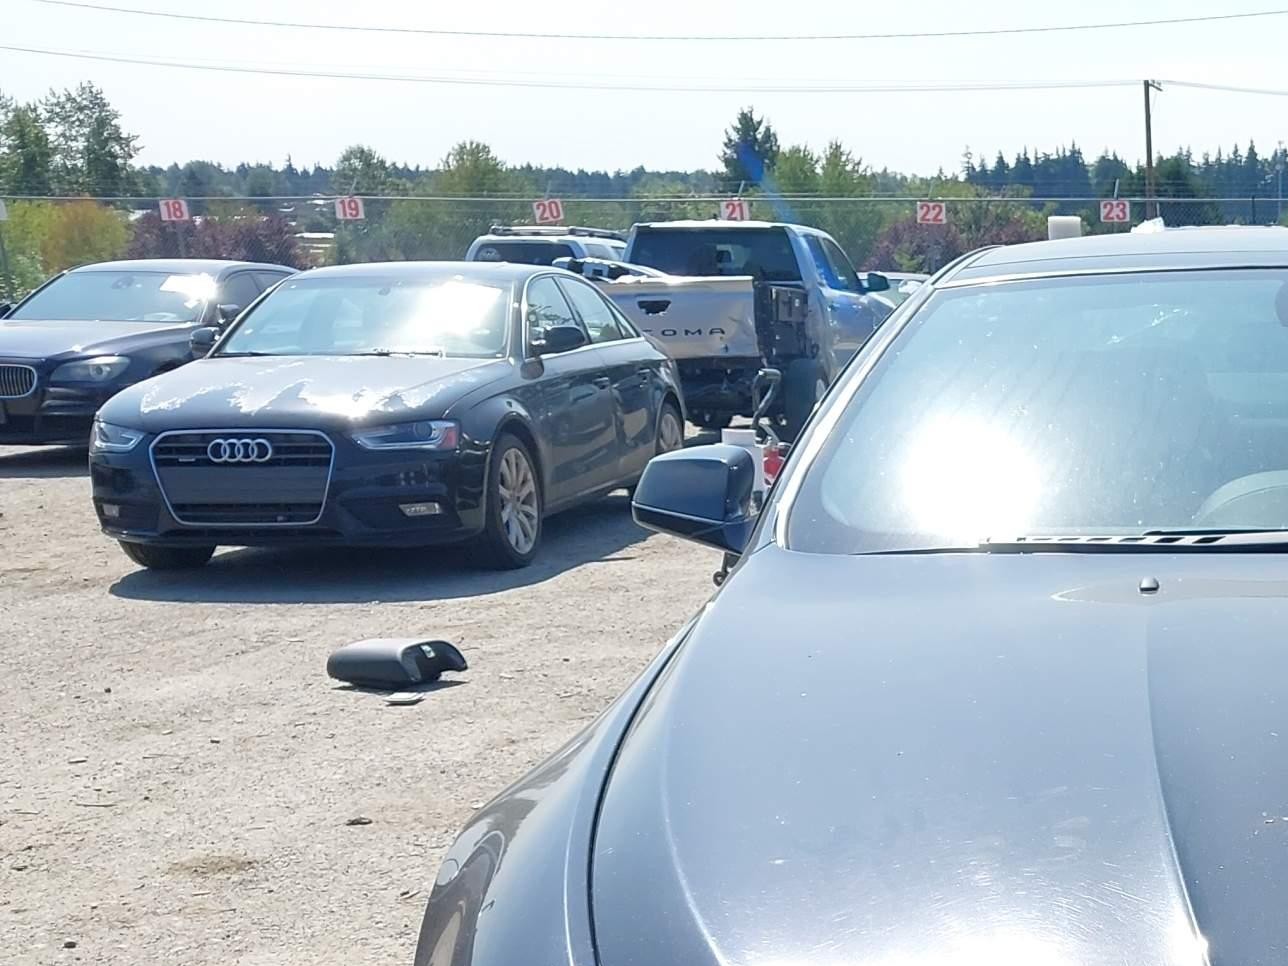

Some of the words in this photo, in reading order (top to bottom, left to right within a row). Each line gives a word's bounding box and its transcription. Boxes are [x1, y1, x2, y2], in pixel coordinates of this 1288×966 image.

[164, 200, 184, 219] 18
[341, 199, 360, 218] 19
[535, 200, 561, 221] 20
[725, 202, 744, 221] 21
[920, 204, 943, 222] 22
[1103, 202, 1126, 221] 23
